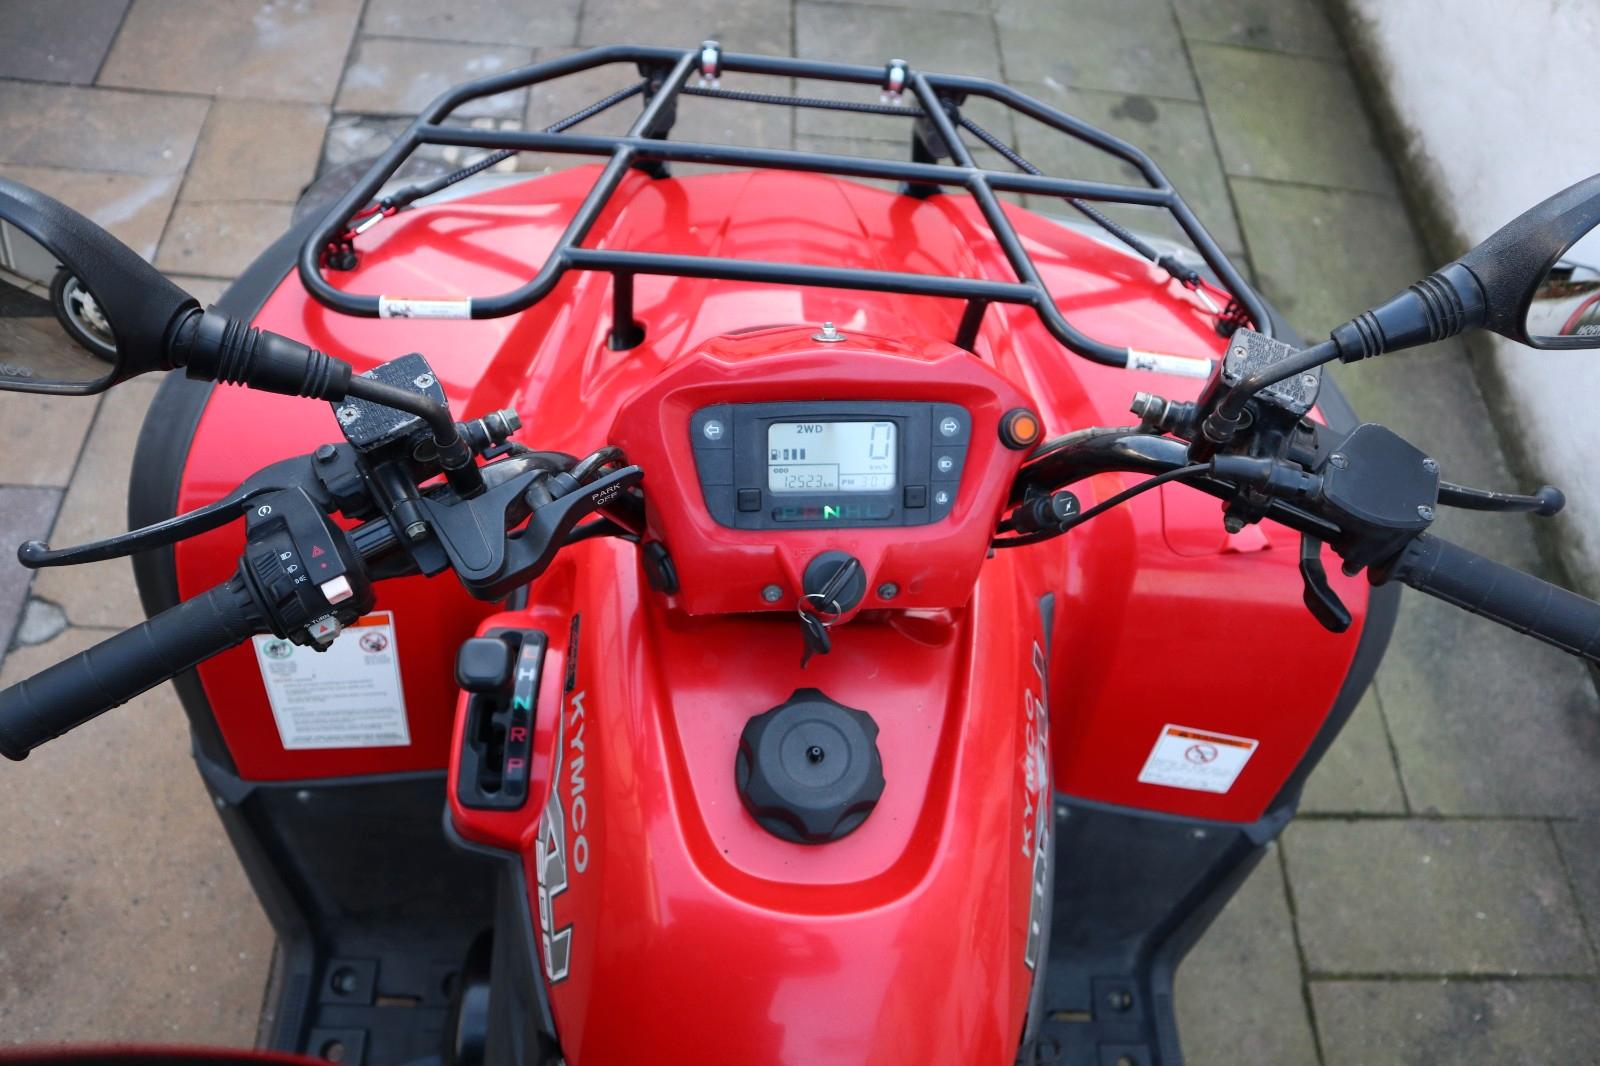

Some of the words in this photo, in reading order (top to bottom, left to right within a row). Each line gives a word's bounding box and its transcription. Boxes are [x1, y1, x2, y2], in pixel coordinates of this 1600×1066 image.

[796, 424, 823, 434] 2WD
[869, 423, 891, 460] 0
[784, 474, 823, 488] 12523
[592, 482, 621, 501] PARK
[823, 505, 841, 520] N
[518, 667, 536, 681] H
[513, 695, 531, 710] N
[510, 727, 528, 742] R
[507, 758, 526, 774] P
[1021, 687, 1036, 858] KYMCO
[570, 690, 589, 874] KYMCO
